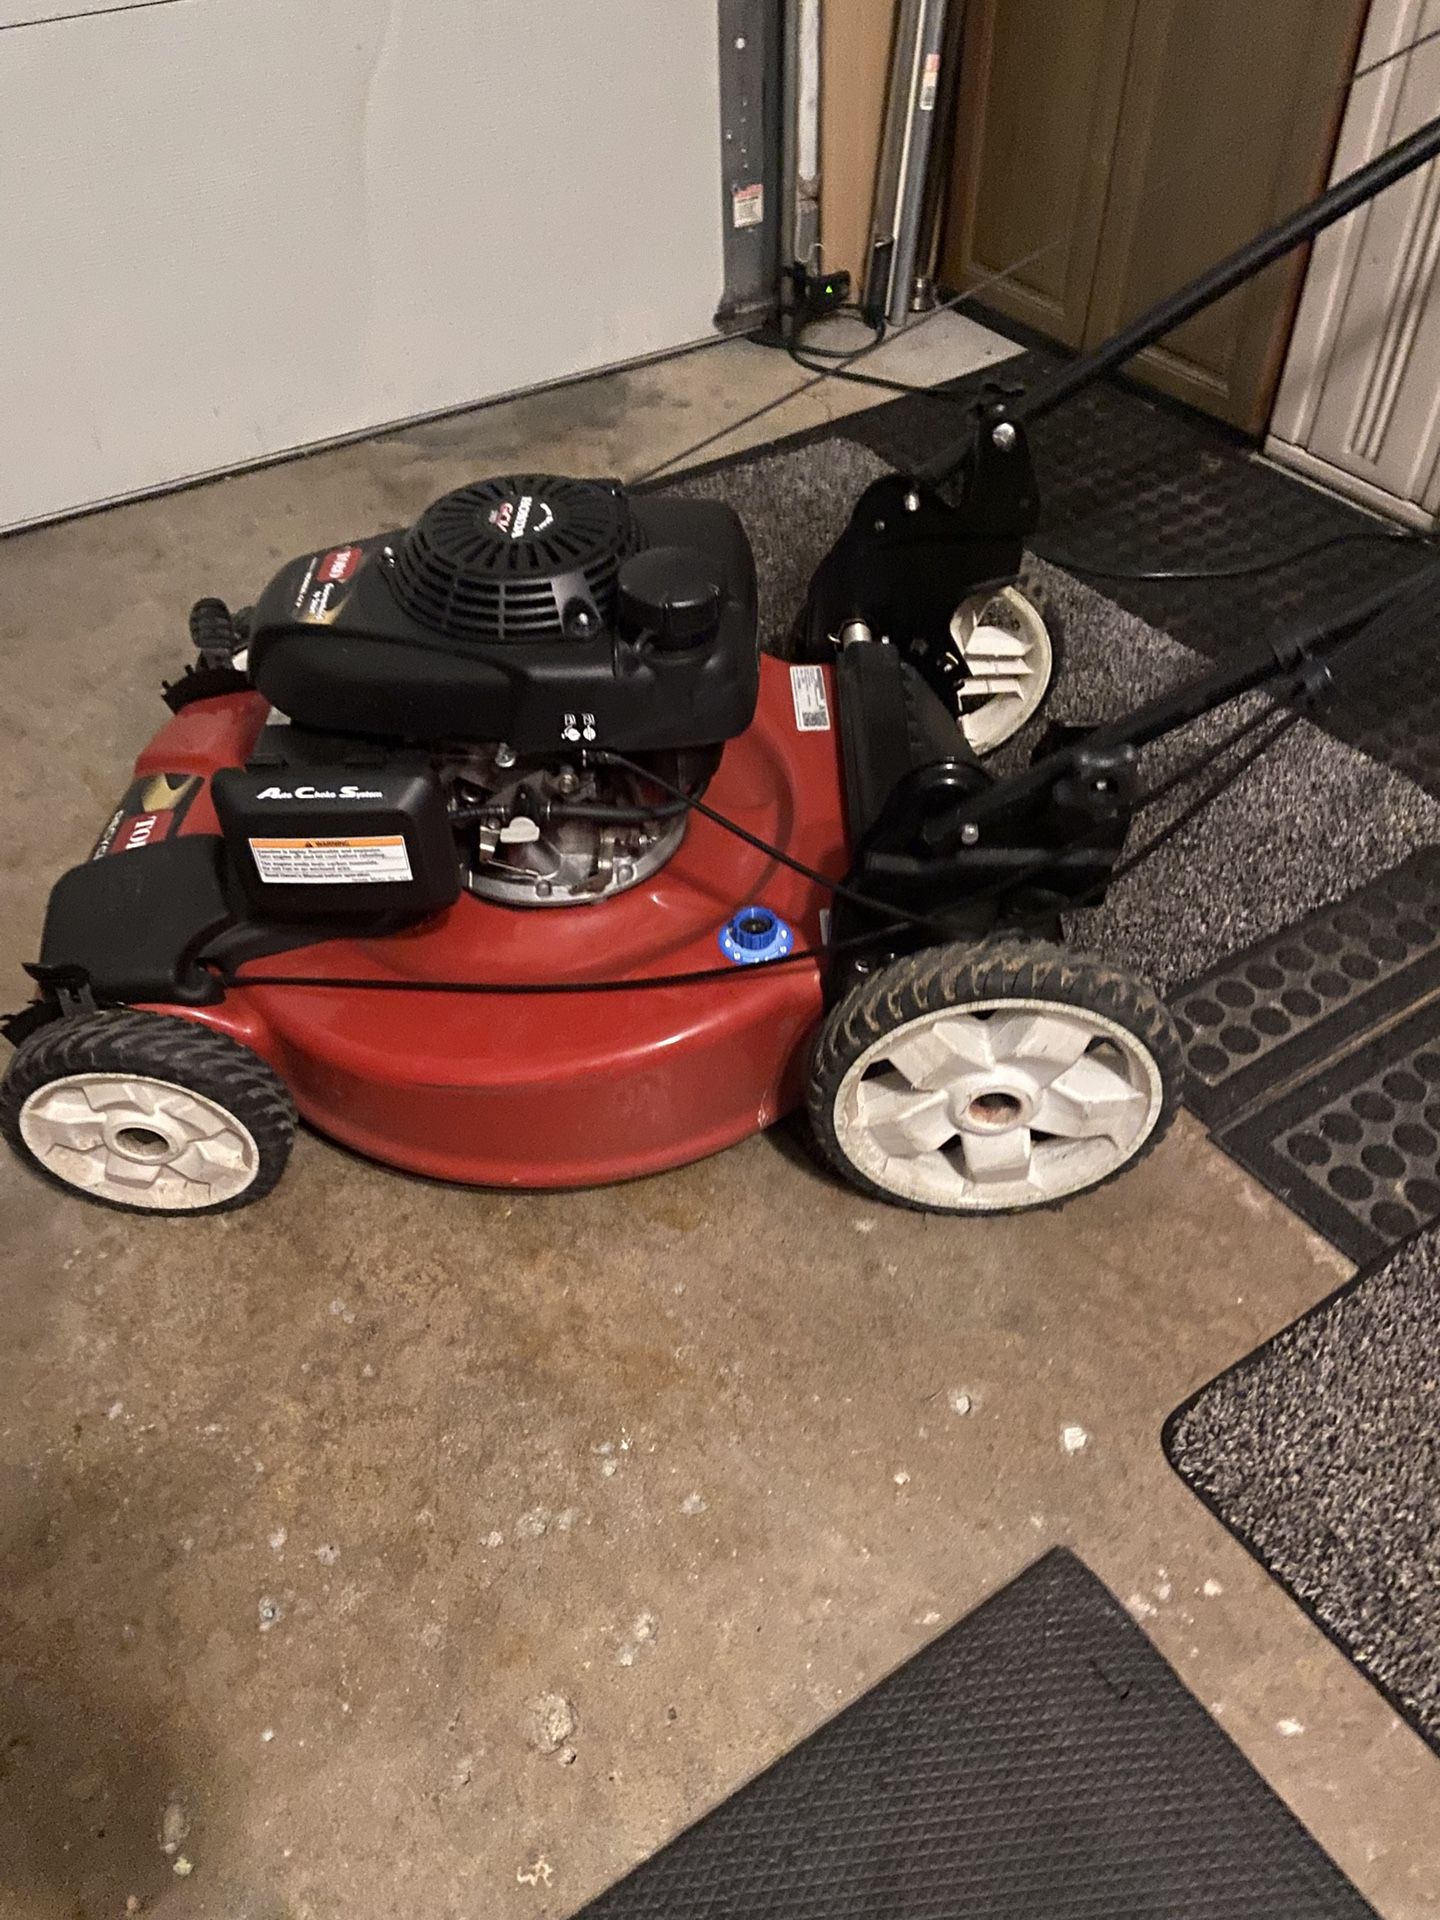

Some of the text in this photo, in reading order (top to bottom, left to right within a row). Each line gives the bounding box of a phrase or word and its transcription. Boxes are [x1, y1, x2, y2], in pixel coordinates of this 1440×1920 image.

[257, 786, 383, 799] Auto Choke System
